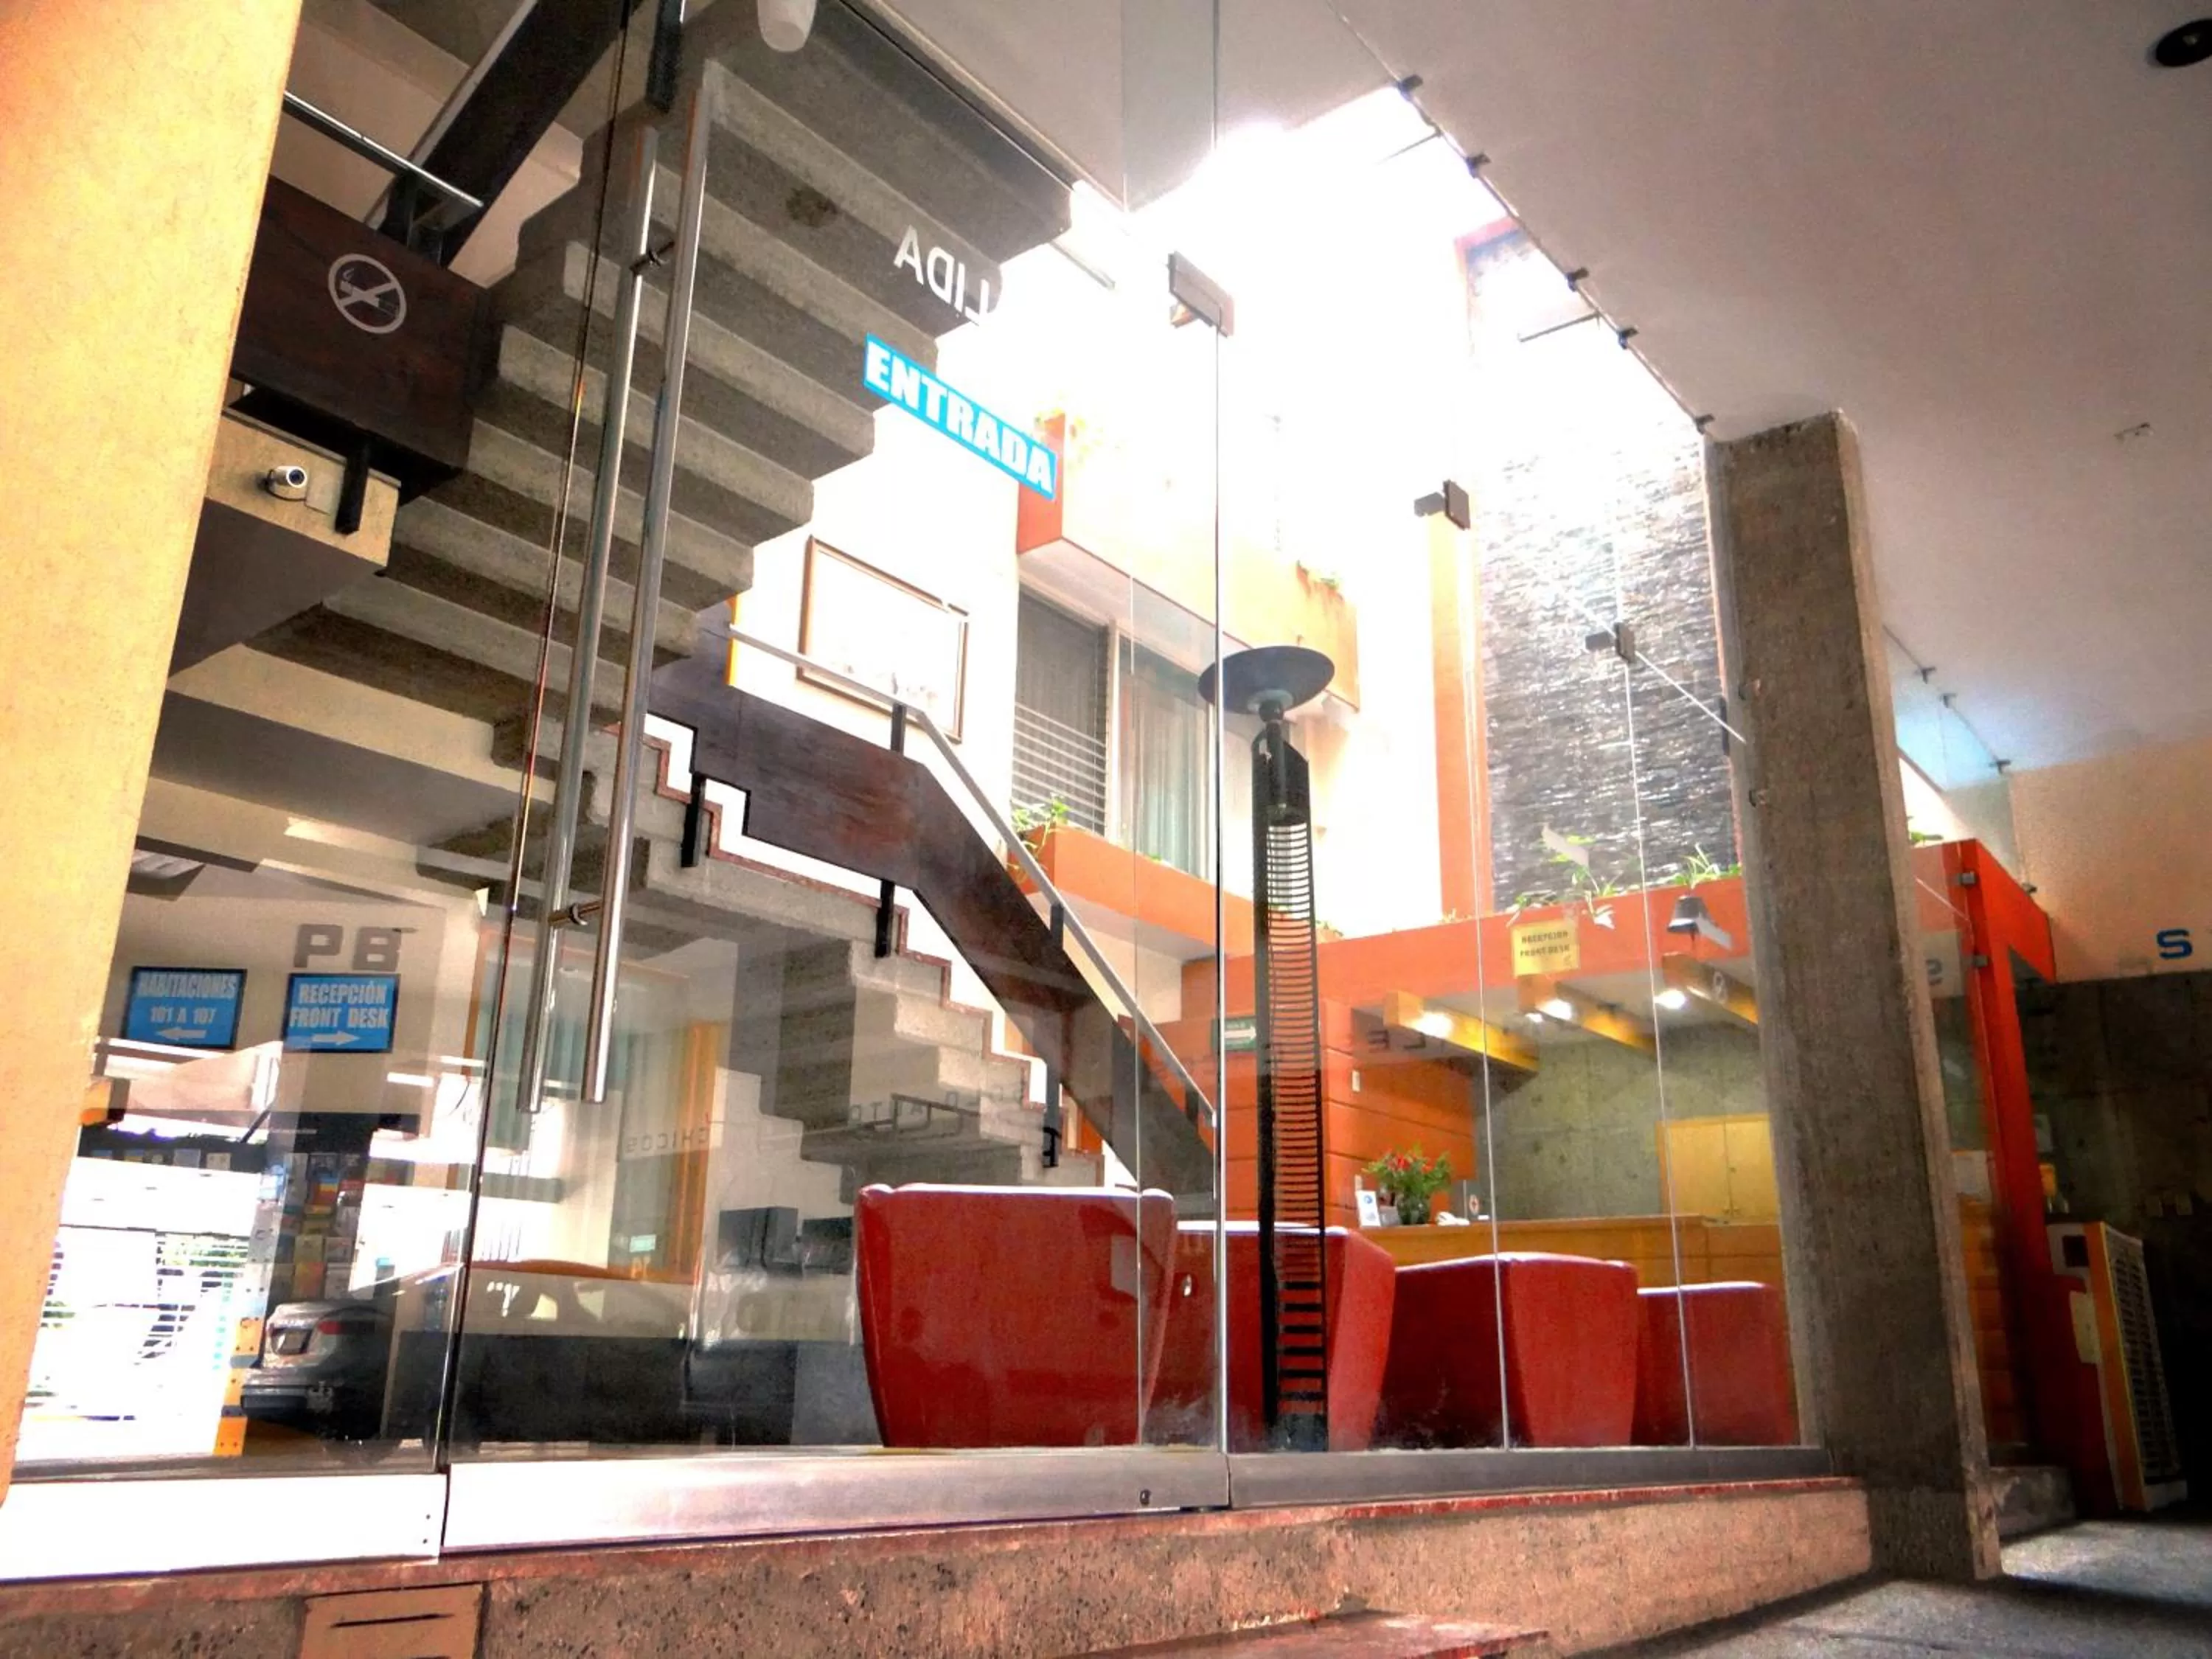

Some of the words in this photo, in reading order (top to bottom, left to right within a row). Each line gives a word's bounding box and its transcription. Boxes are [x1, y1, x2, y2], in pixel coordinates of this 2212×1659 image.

[866, 340, 1053, 493] ENTRADA
[293, 925, 401, 971] PB
[136, 972, 238, 998] HABITACIONES
[298, 980, 387, 1004] RECEPCIÓN
[289, 1007, 341, 1027] FRONT
[347, 1008, 389, 1028] DESK
